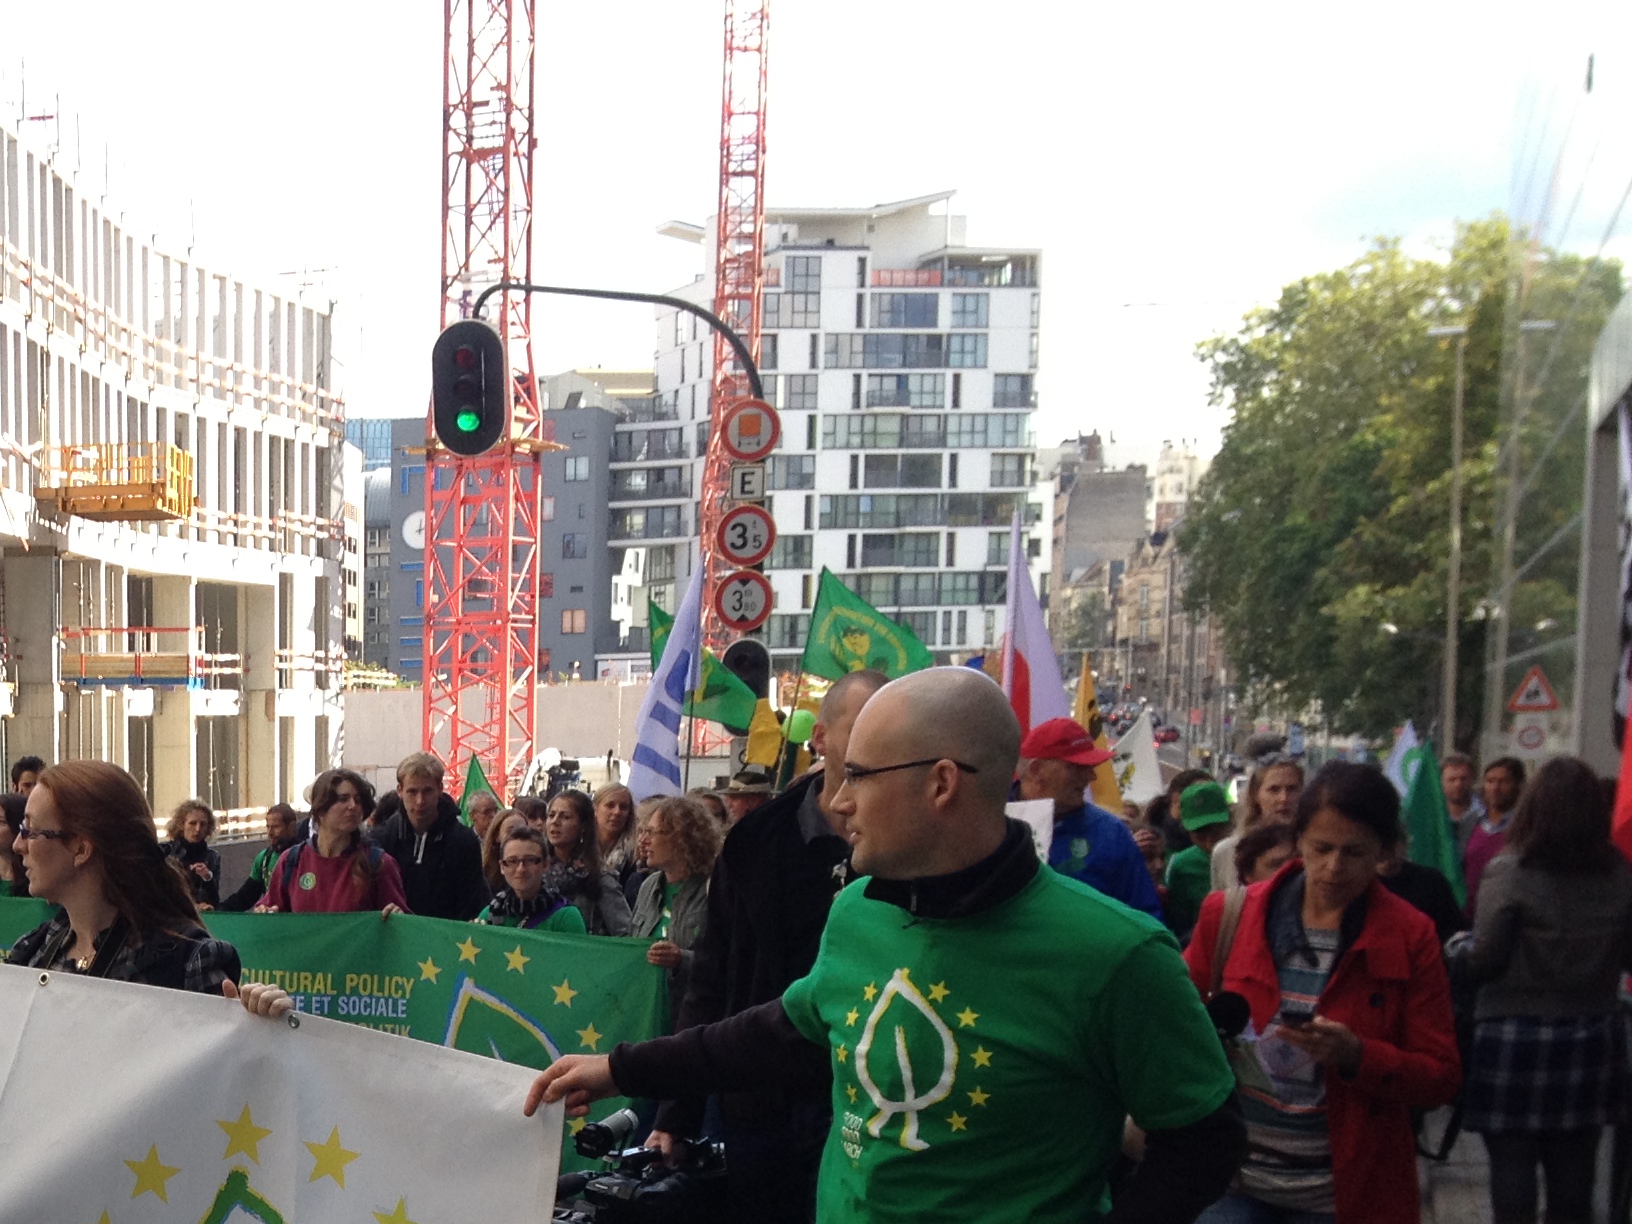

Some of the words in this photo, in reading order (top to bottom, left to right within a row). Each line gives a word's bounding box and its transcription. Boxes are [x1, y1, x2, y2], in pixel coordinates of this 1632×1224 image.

[740, 471, 756, 495] E
[345, 972, 416, 999] POLICY
[311, 996, 329, 1015] ET
[338, 996, 408, 1018] SOCIALE
